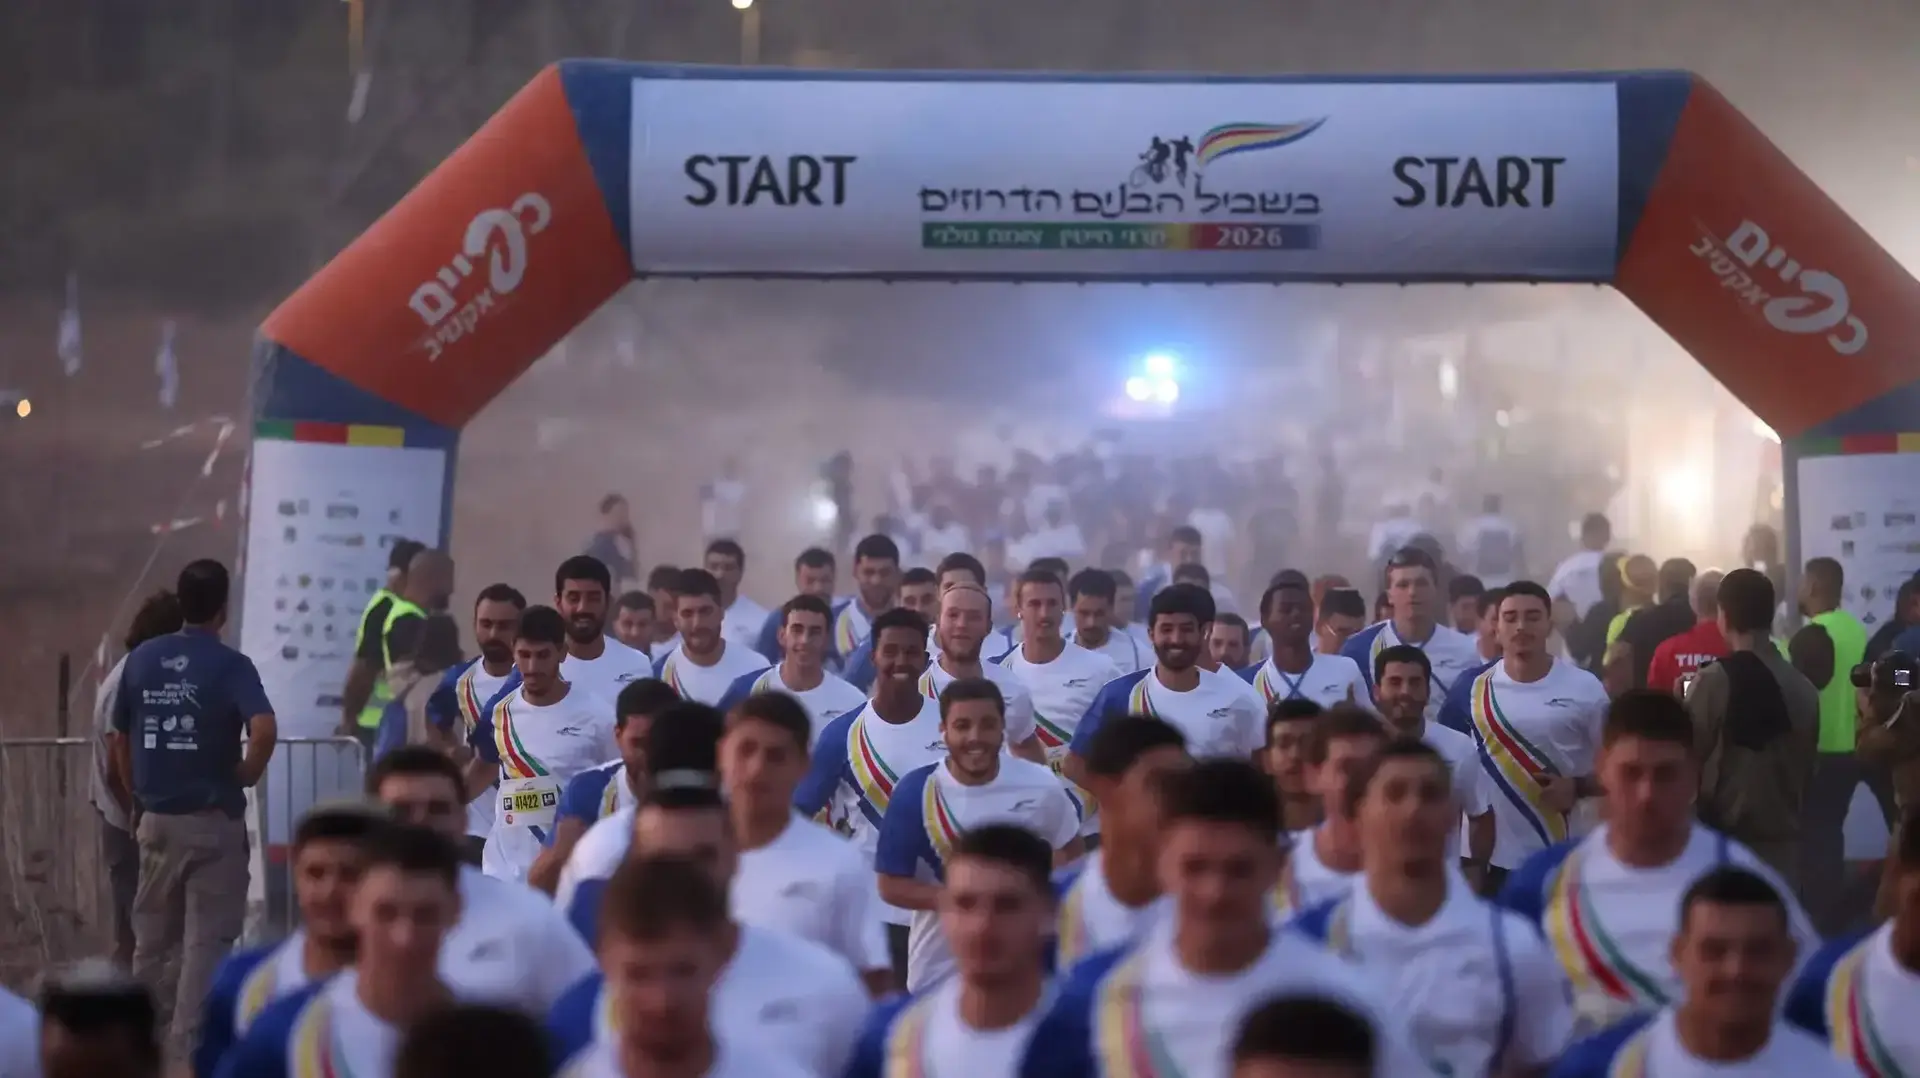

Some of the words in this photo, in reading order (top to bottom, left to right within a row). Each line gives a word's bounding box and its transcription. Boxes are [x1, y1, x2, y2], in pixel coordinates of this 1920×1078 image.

[684, 154, 857, 207] START
[1195, 174, 1323, 216] בשביל
[1393, 156, 1566, 208] START
[919, 187, 1062, 214] הדרוזים
[1073, 184, 1186, 219] הבנים
[1215, 226, 1283, 247] 2026
[1674, 653, 1717, 667] TIM
[515, 793, 539, 811] 41422
